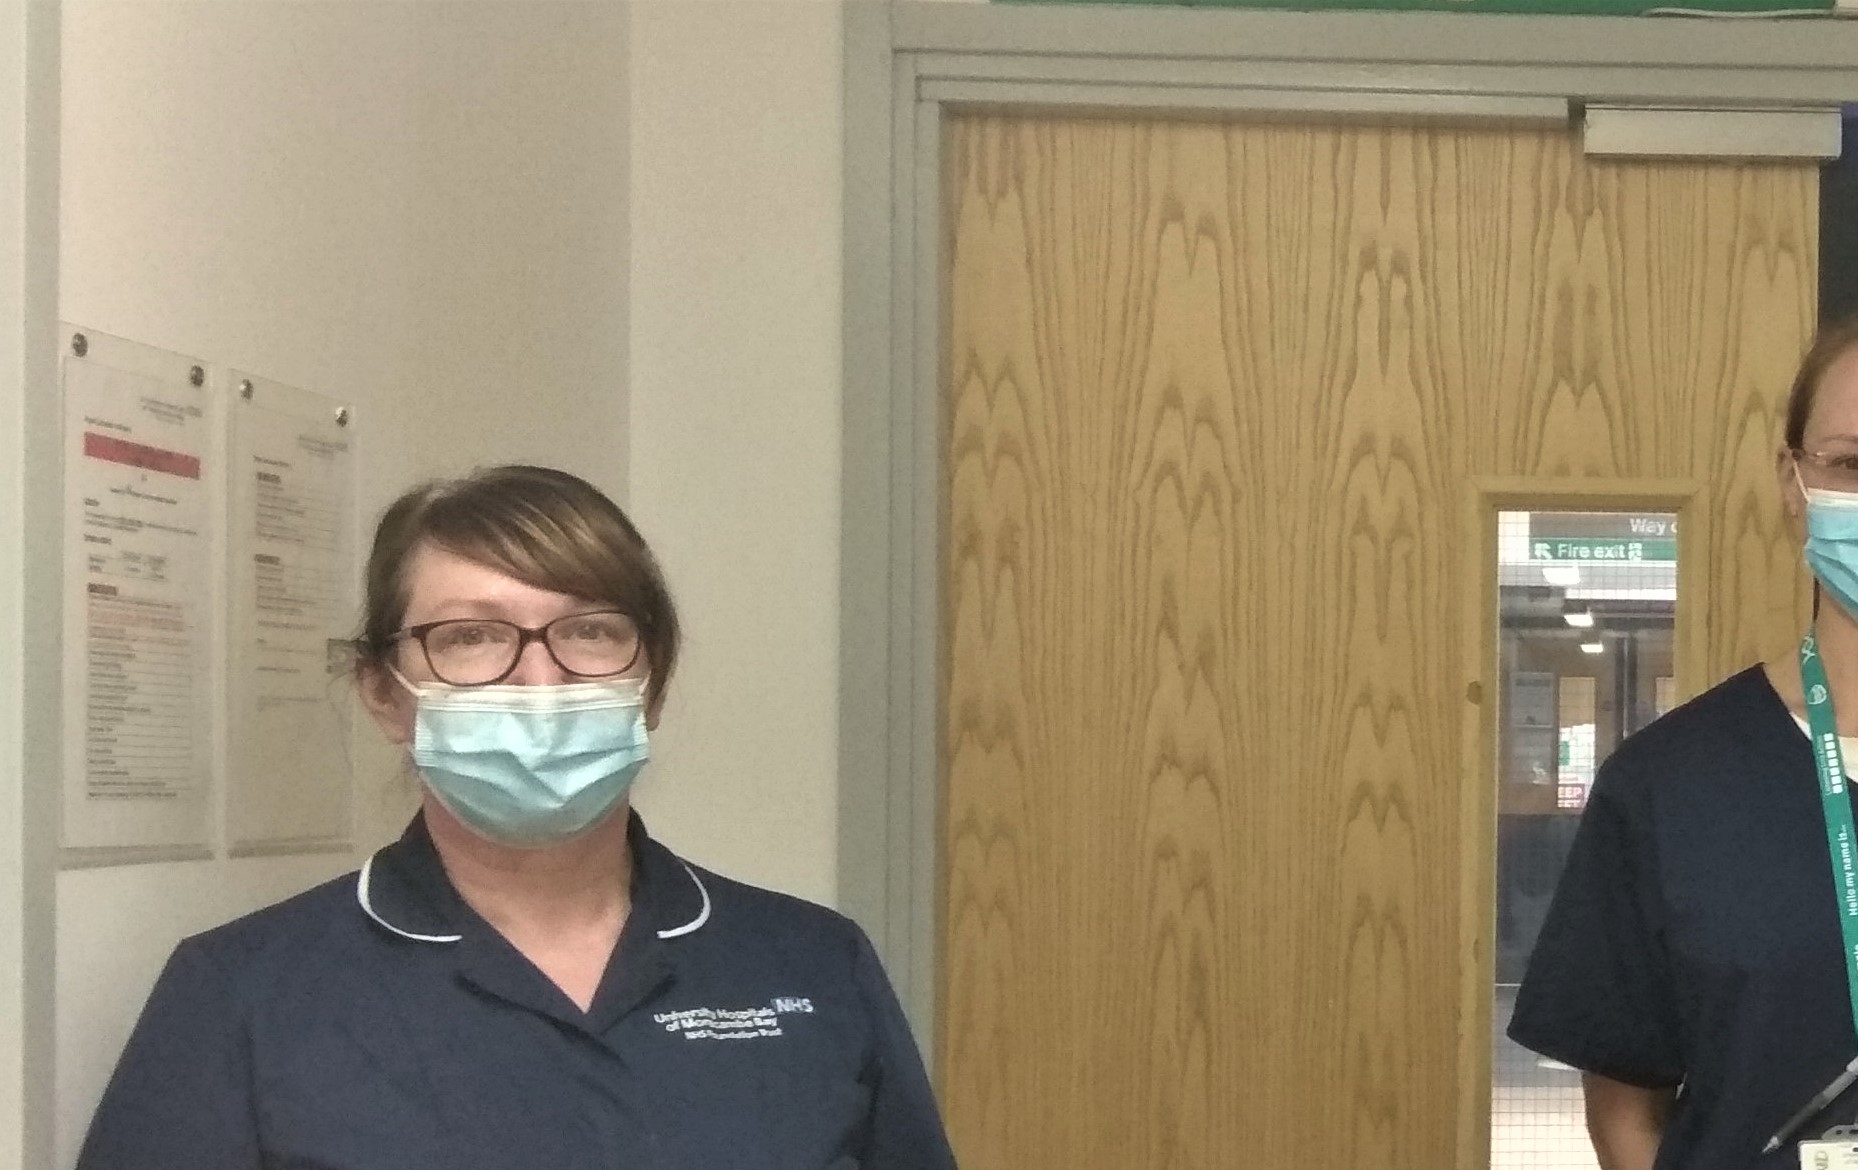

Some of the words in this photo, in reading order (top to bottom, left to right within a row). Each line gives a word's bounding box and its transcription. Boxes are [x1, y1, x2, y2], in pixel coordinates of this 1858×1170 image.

[1630, 518, 1667, 536] Way
[1557, 543, 1591, 559] Fire
[1593, 543, 1626, 559] exit
[1840, 842, 1852, 870] name
[1845, 871, 1855, 887] my
[774, 998, 814, 1012] NHS
[653, 1008, 716, 1023] University
[716, 1007, 775, 1020] Hospitals
[665, 1020, 681, 1032] of
